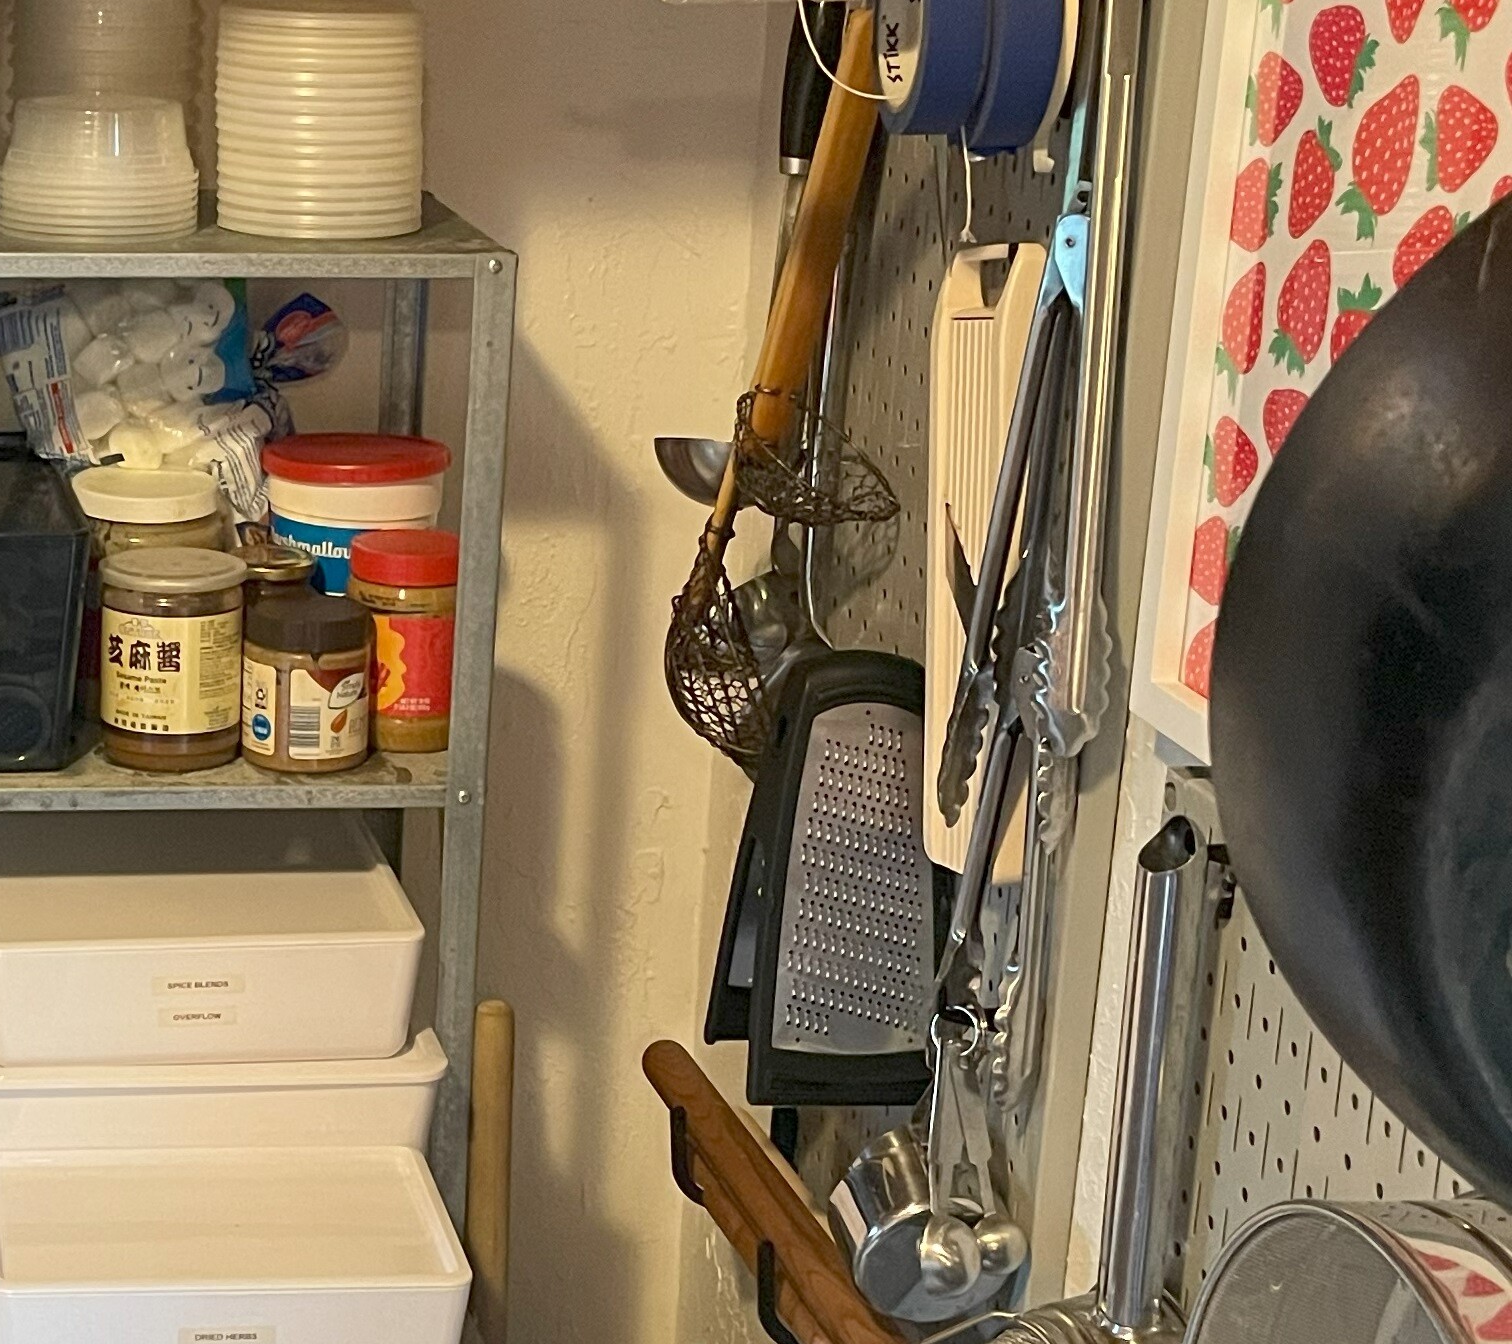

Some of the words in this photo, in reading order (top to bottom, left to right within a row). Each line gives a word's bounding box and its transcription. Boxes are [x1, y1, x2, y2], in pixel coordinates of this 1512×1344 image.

[883, 22, 903, 83] STIKK
[108, 633, 181, 673] 芝麻醬
[194, 980, 229, 989] BLENDS
[173, 1013, 221, 1021] OVERFLOW
[194, 1334, 223, 1342] DRIED
[226, 1333, 257, 1341] HERBS
